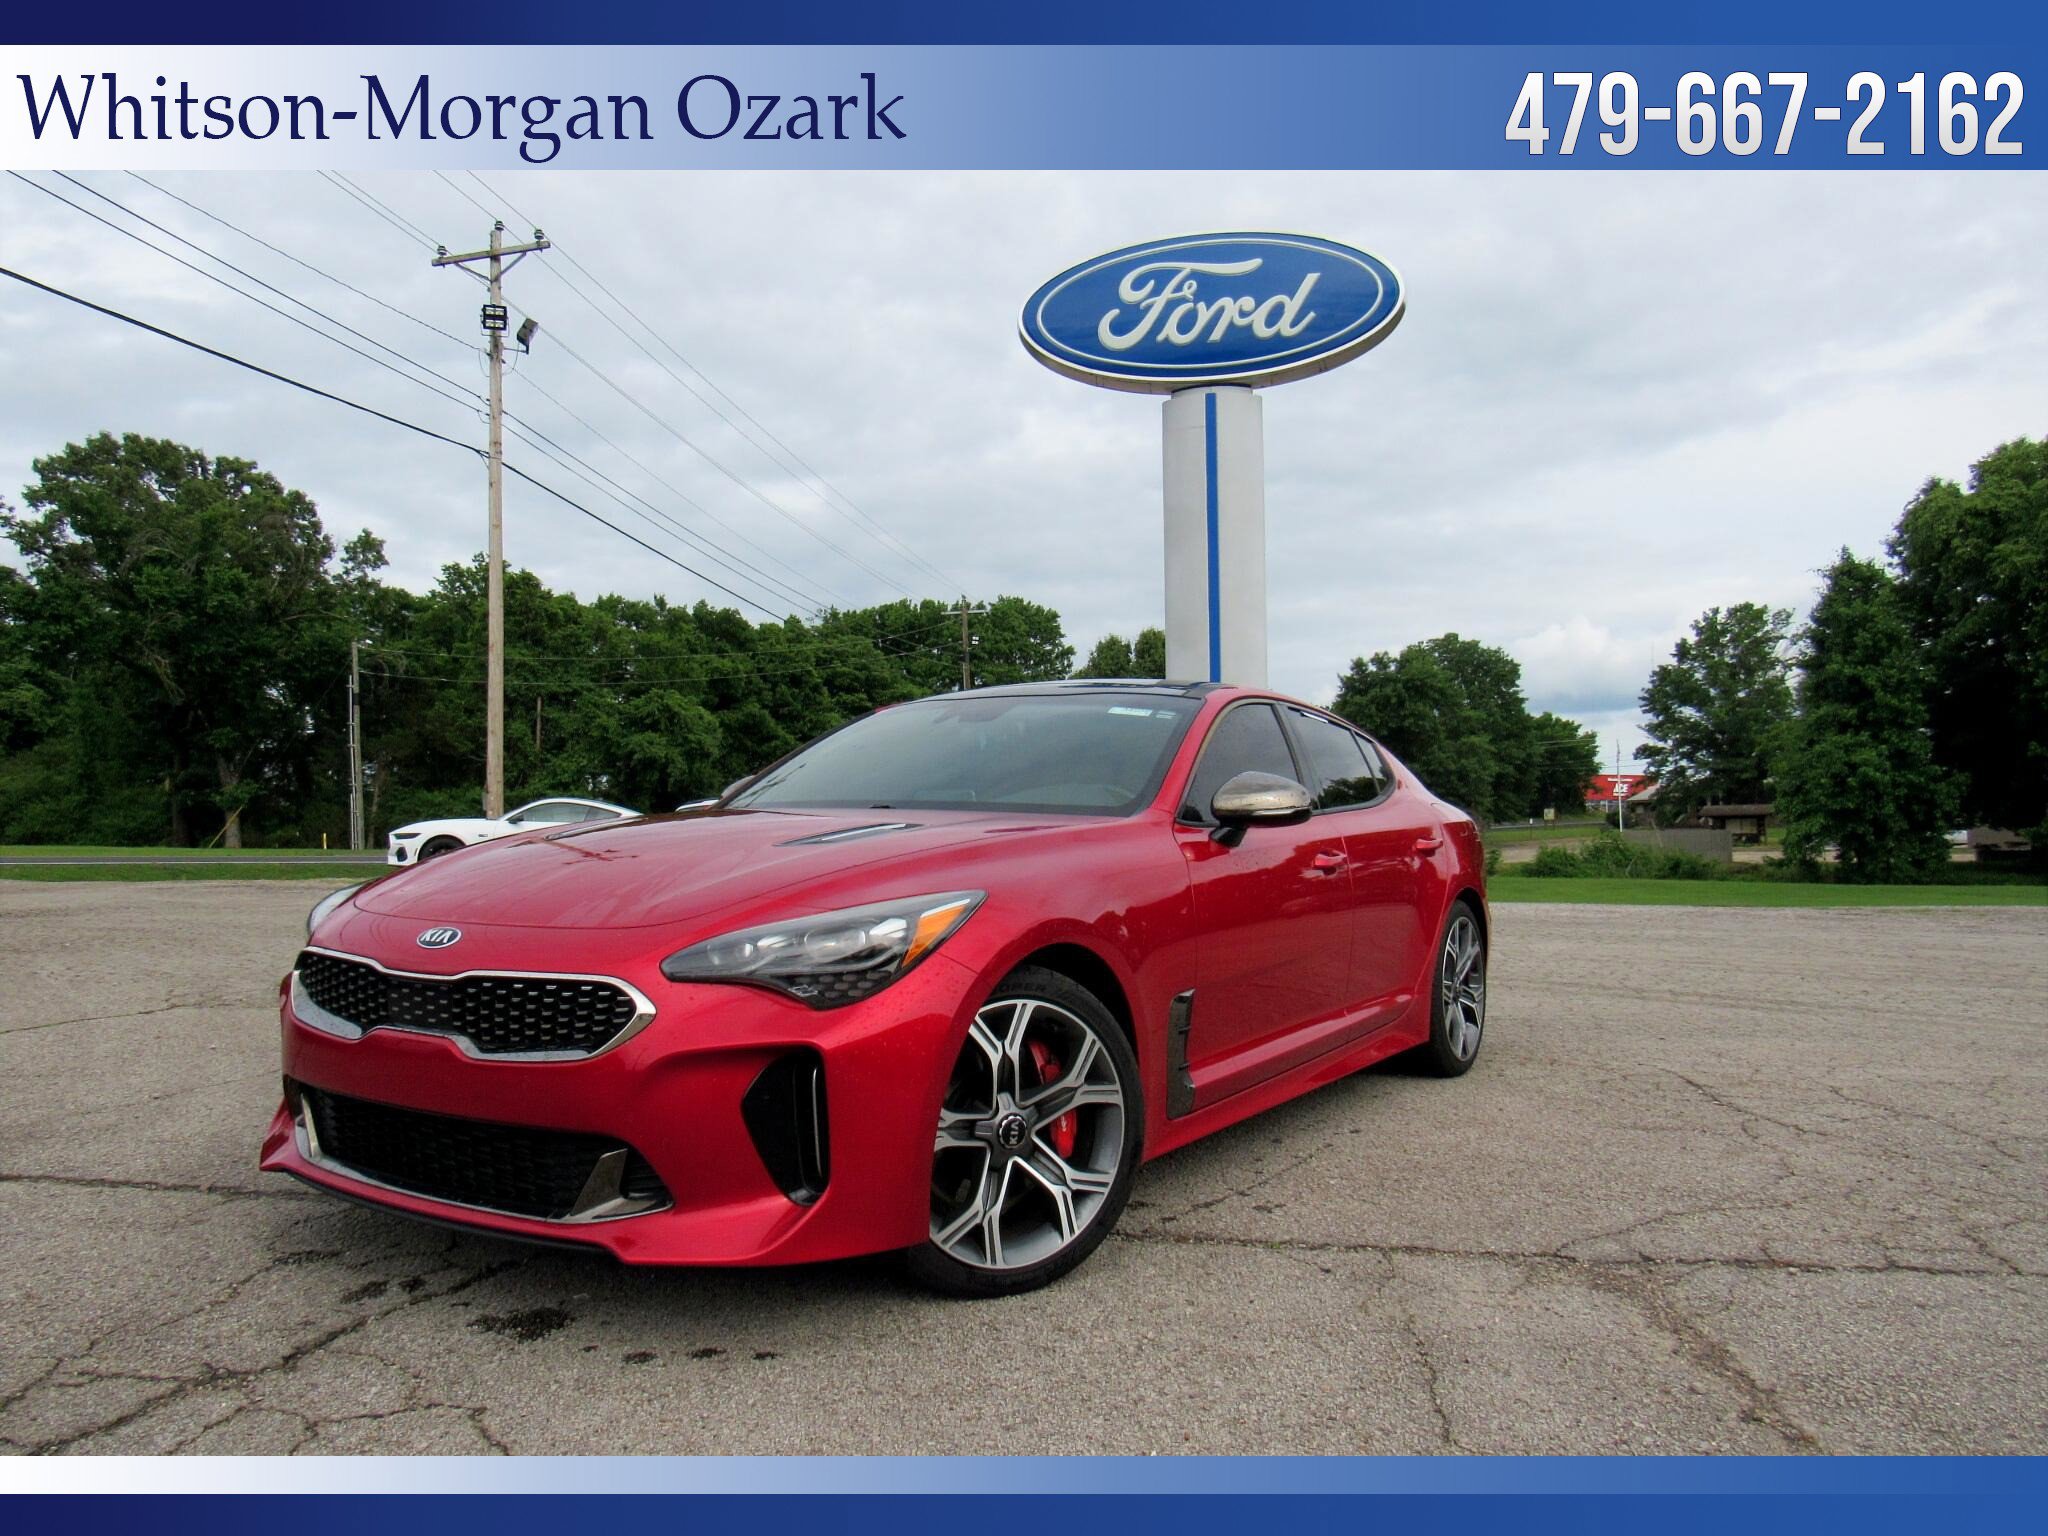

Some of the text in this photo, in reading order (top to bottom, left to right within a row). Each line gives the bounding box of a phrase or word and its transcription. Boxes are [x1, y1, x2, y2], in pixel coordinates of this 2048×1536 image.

[1098, 258, 1321, 351] Ford
[419, 929, 454, 944] KIA
[1009, 1120, 1020, 1145] KIA
